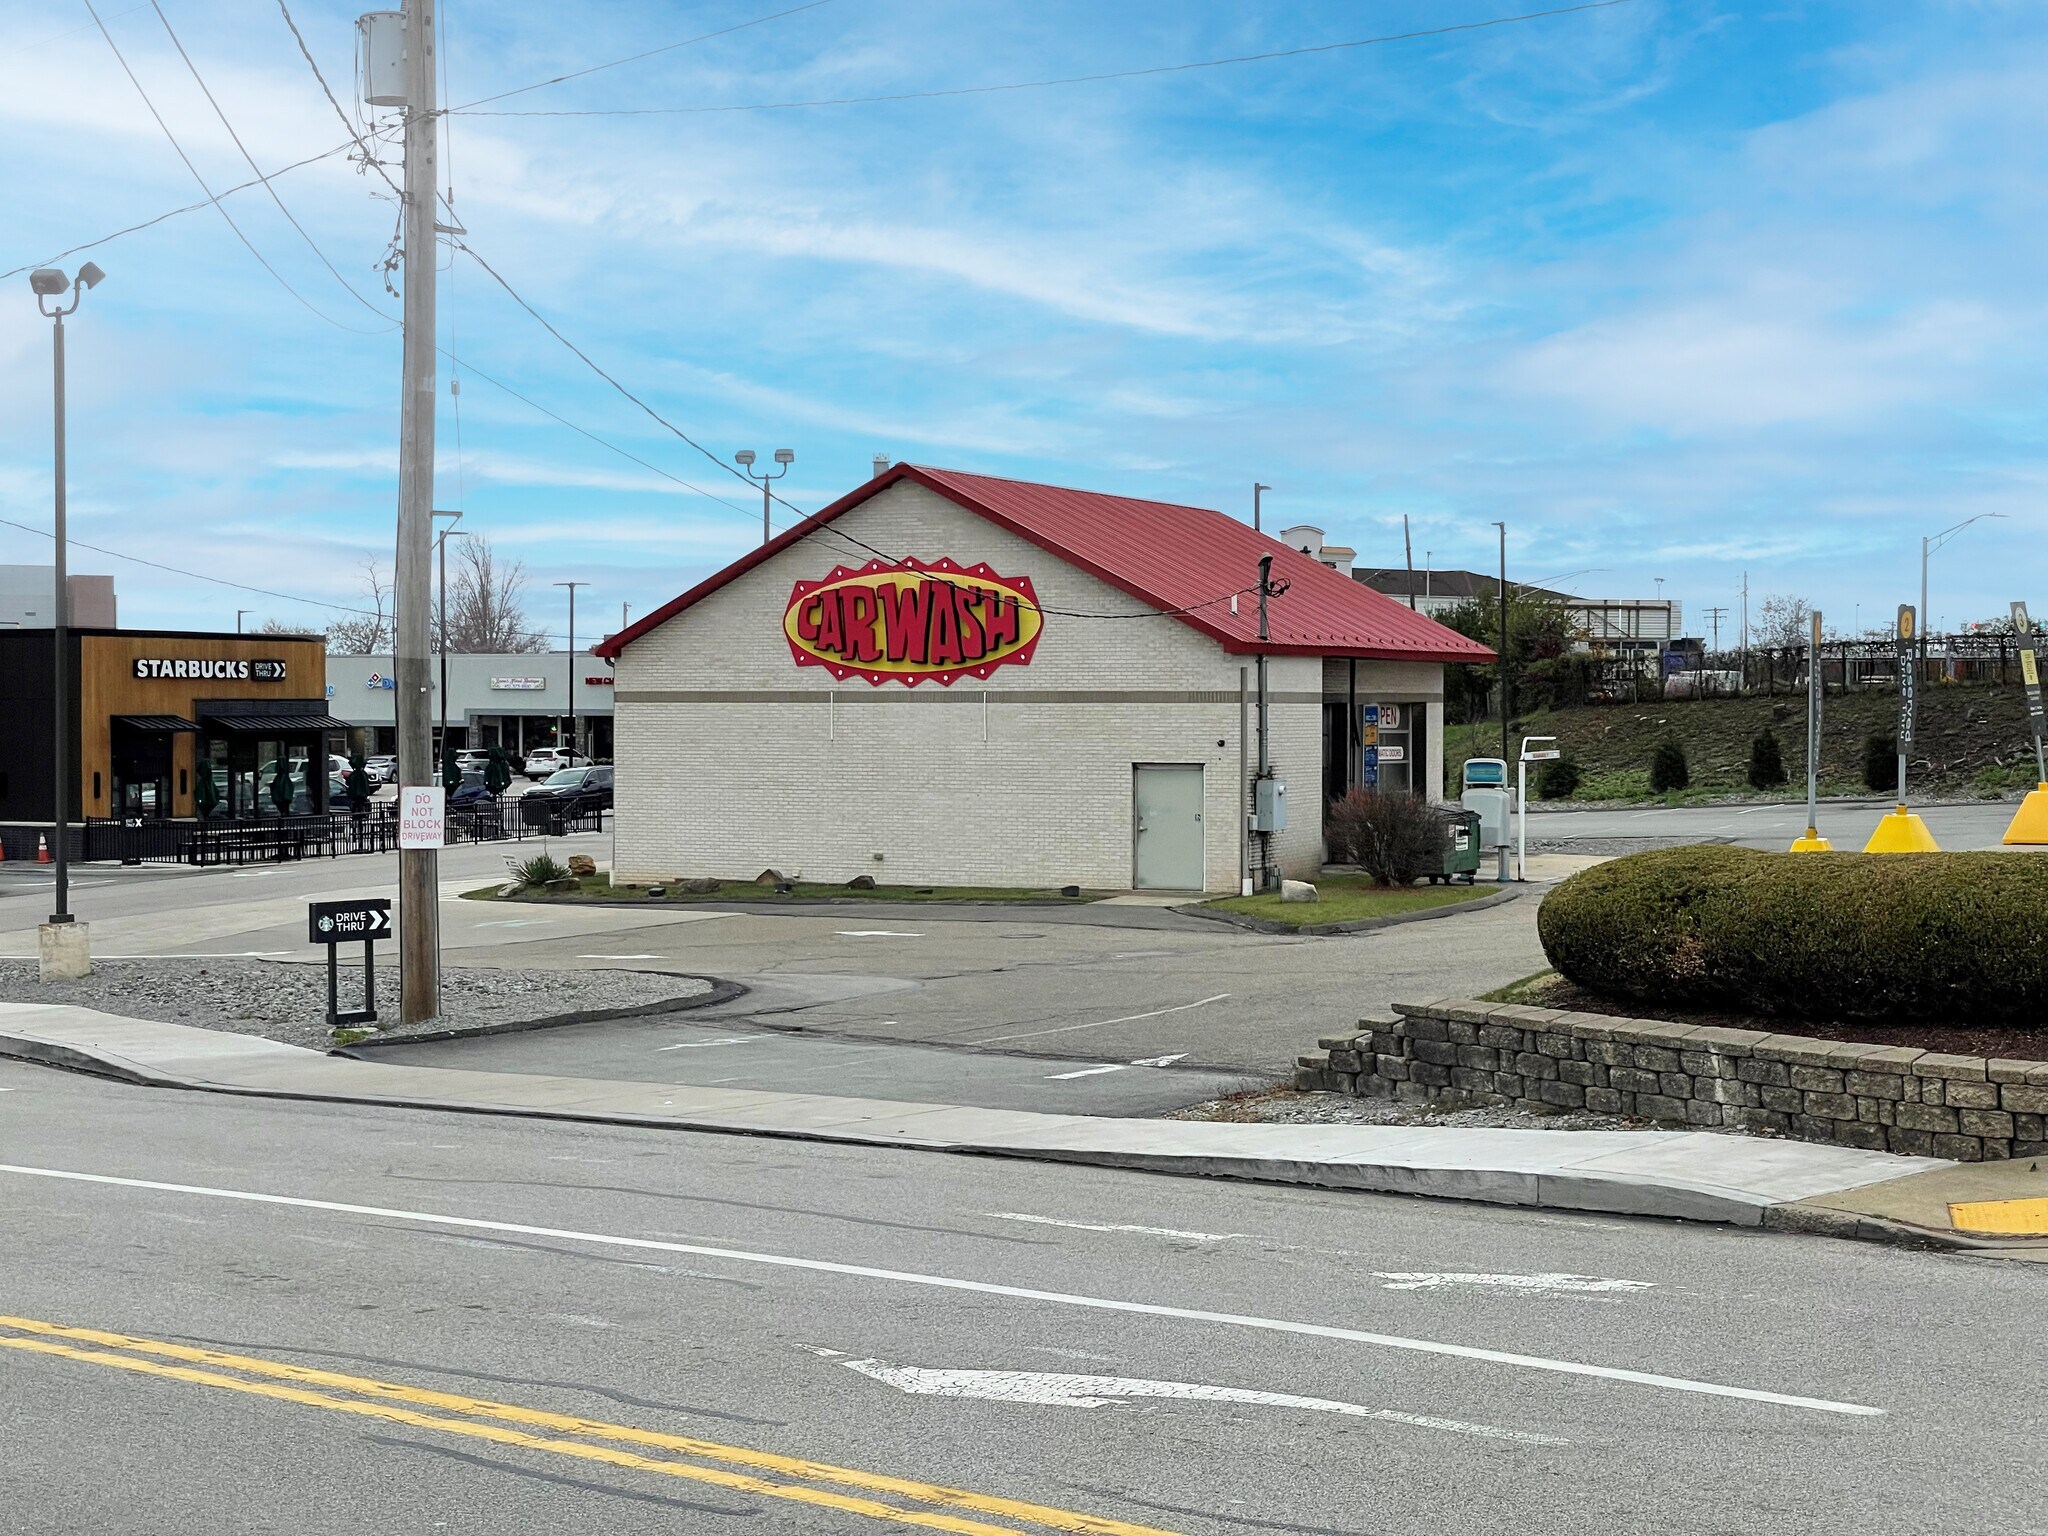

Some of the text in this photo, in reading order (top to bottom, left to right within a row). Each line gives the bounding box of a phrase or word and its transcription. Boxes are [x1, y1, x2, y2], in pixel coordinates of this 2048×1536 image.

[798, 580, 1019, 665] CAR WASH
[1904, 617, 1910, 632] 2
[137, 659, 249, 679] STARBUCKS
[254, 662, 272, 670] DRIVE
[585, 677, 602, 685] NEW
[1904, 648, 1913, 742] Reserved
[1380, 706, 1397, 725] PEN
[415, 794, 431, 804] DO
[411, 807, 434, 817] NOT
[403, 819, 441, 829] BLOCK
[402, 832, 442, 841] DRIVEWAY
[335, 911, 367, 922] DRIVE
[336, 921, 365, 932] THRU
